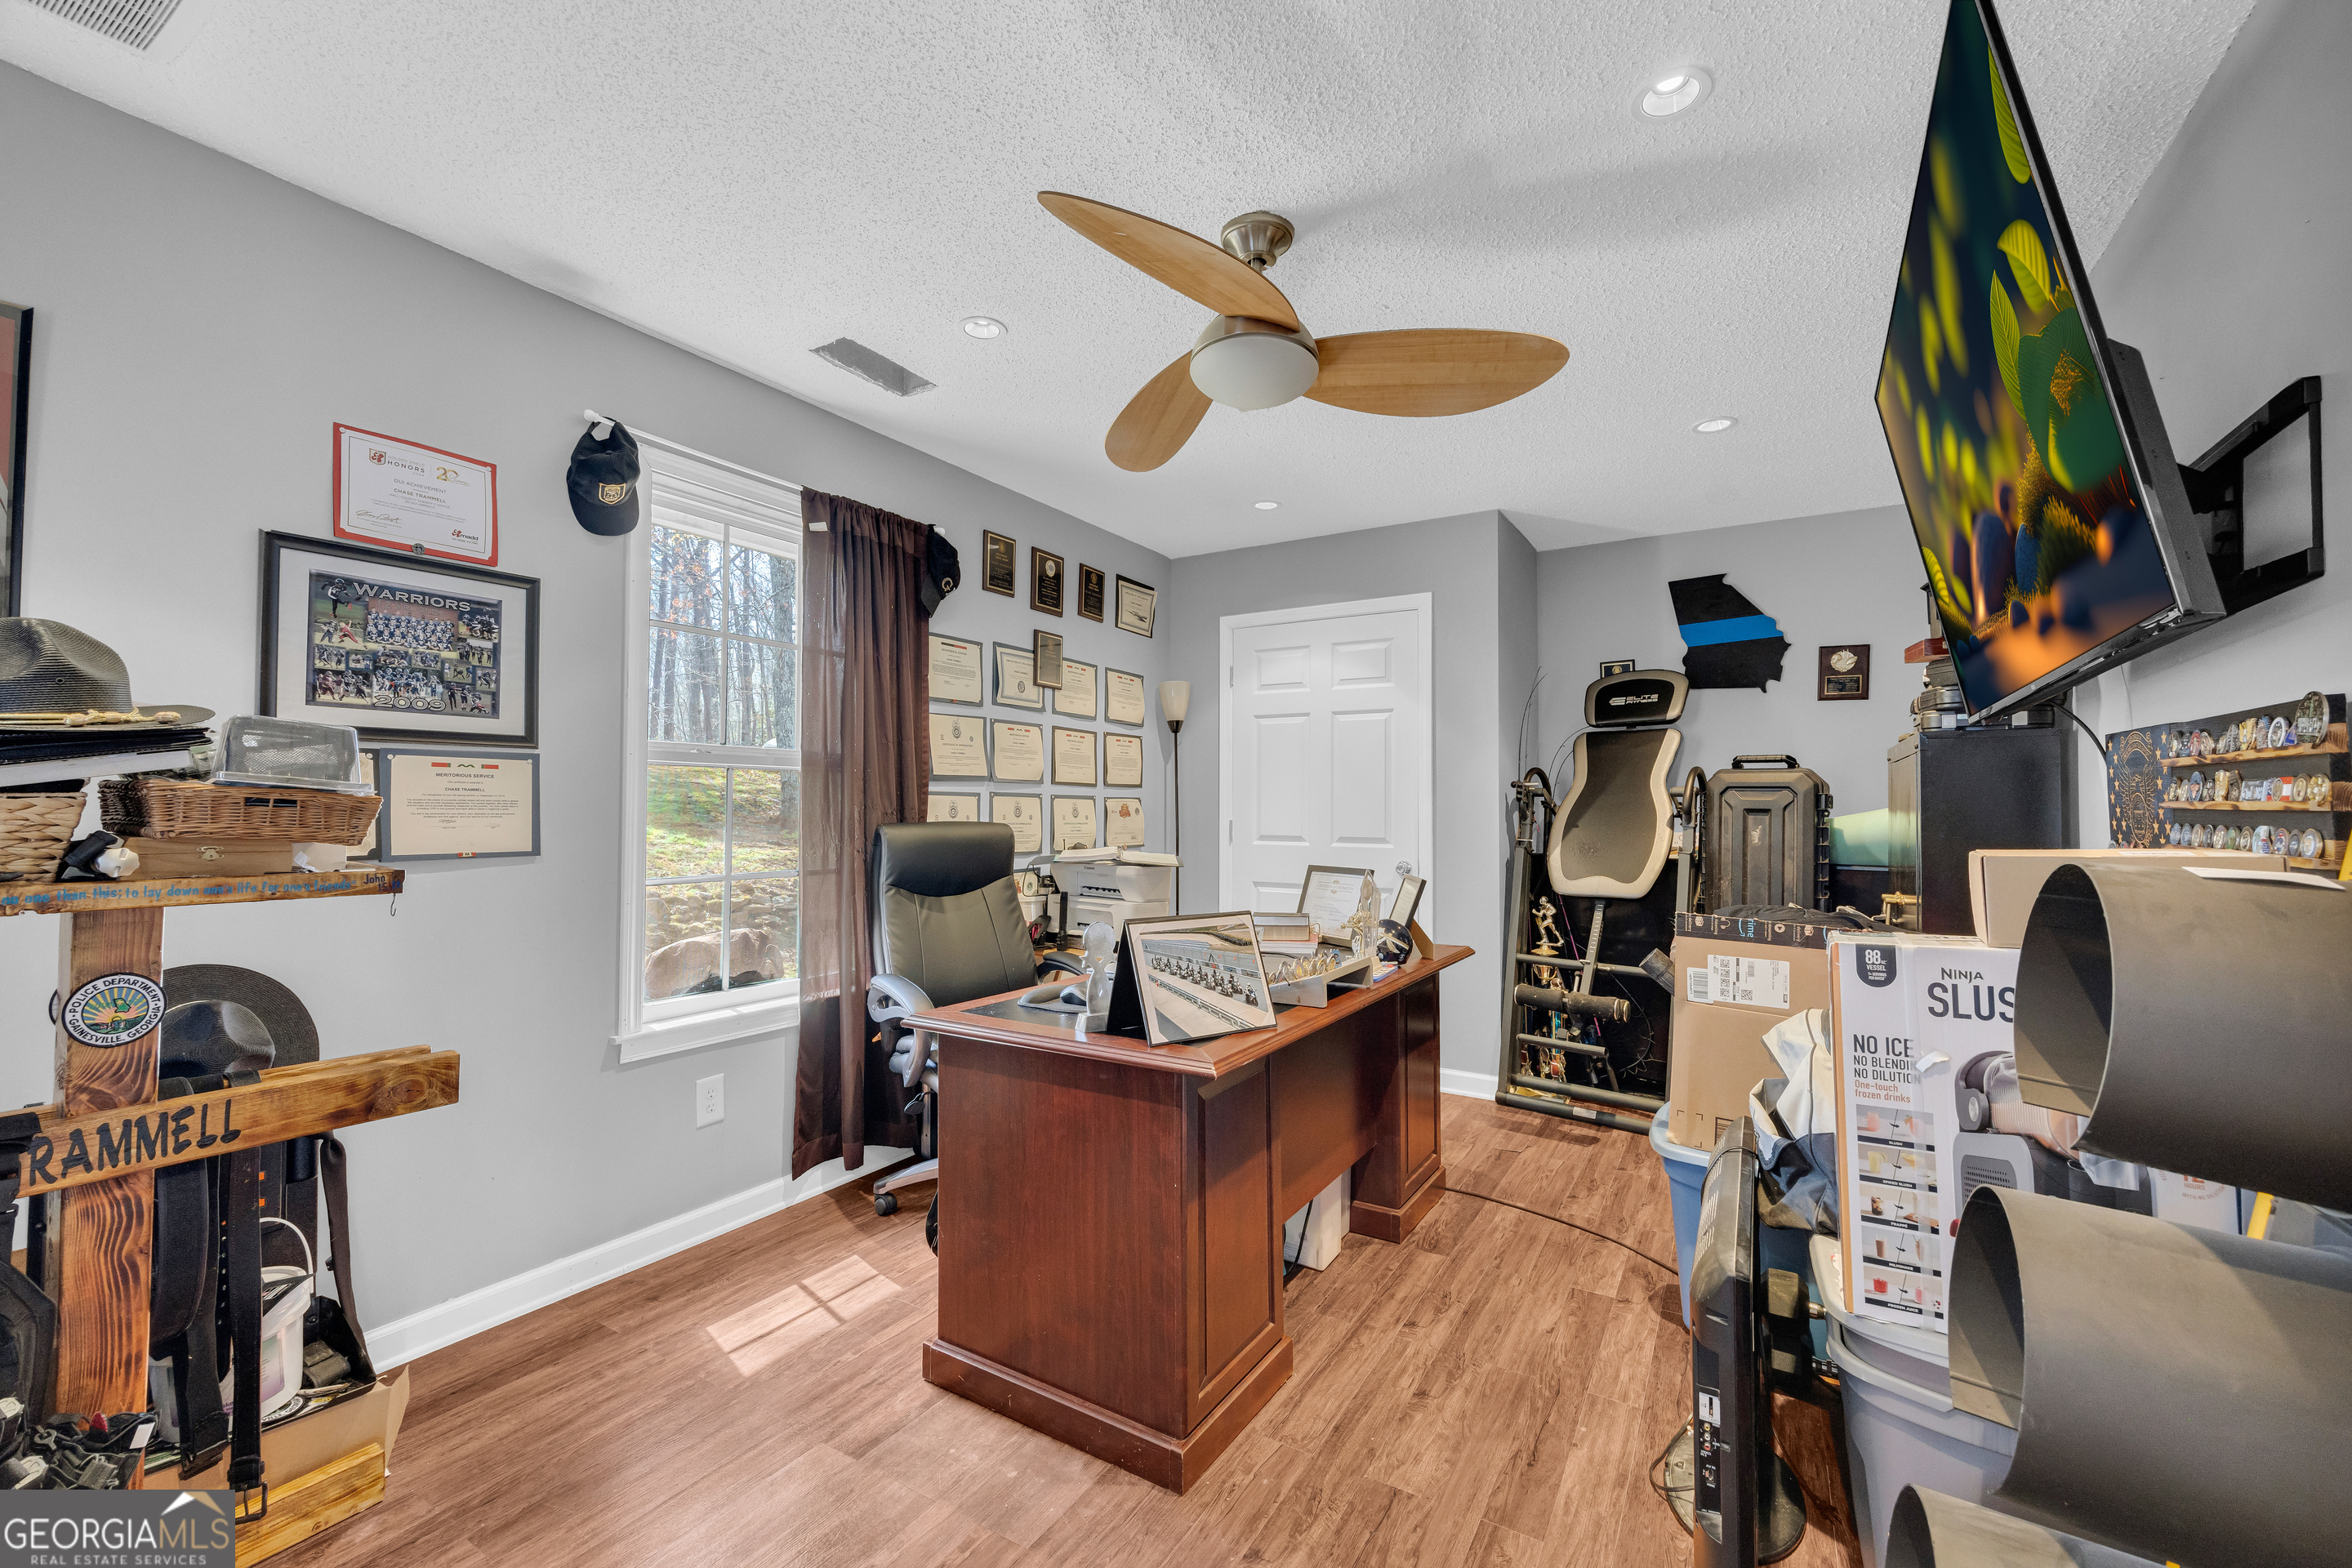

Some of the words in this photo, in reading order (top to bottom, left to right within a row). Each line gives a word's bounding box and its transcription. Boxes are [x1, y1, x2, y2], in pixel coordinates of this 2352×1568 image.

[387, 460, 425, 474] HONORS
[406, 481, 447, 494] ACHIEVEMENT
[394, 488, 414, 497] CHASE
[415, 492, 447, 504] TRAMMELL
[460, 533, 479, 541] madd
[353, 581, 471, 612] WARRIORS
[373, 695, 447, 712] 2009
[363, 873, 385, 884] John
[1, 895, 19, 906] no
[24, 892, 50, 904] one
[56, 889, 87, 902] than
[92, 886, 122, 899] this;
[125, 887, 139, 898] to
[143, 885, 162, 901] lay
[167, 884, 199, 897] down
[203, 882, 234, 895] one's
[237, 881, 257, 893] life
[262, 881, 279, 893] for
[283, 882, 310, 892] one's
[377, 882, 387, 892] 15
[1865, 949, 1881, 964] 88
[1940, 967, 1984, 983] NINJA
[69, 983, 101, 1013] POLICE
[103, 978, 161, 1003] DEPARTMENT
[1927, 982, 2016, 1023] SLUS
[127, 1005, 162, 1039] GEORGIA
[1853, 1034, 1878, 1054] NO
[1886, 1037, 1914, 1058] ICE
[1854, 1055, 1867, 1066] NO
[1872, 1057, 1917, 1071] BLENDIN
[1855, 1067, 1868, 1079] NO
[1873, 1069, 1921, 1085] DILUTION
[1855, 1080, 1899, 1093] One-touch
[1855, 1089, 1881, 1099] frozen
[1884, 1093, 1911, 1103] drinks
[28, 1098, 242, 1187] RAMMELL
[2184, 1183, 2205, 1191] HOURS
[1889, 1263, 1913, 1271] MILKSHAKE
